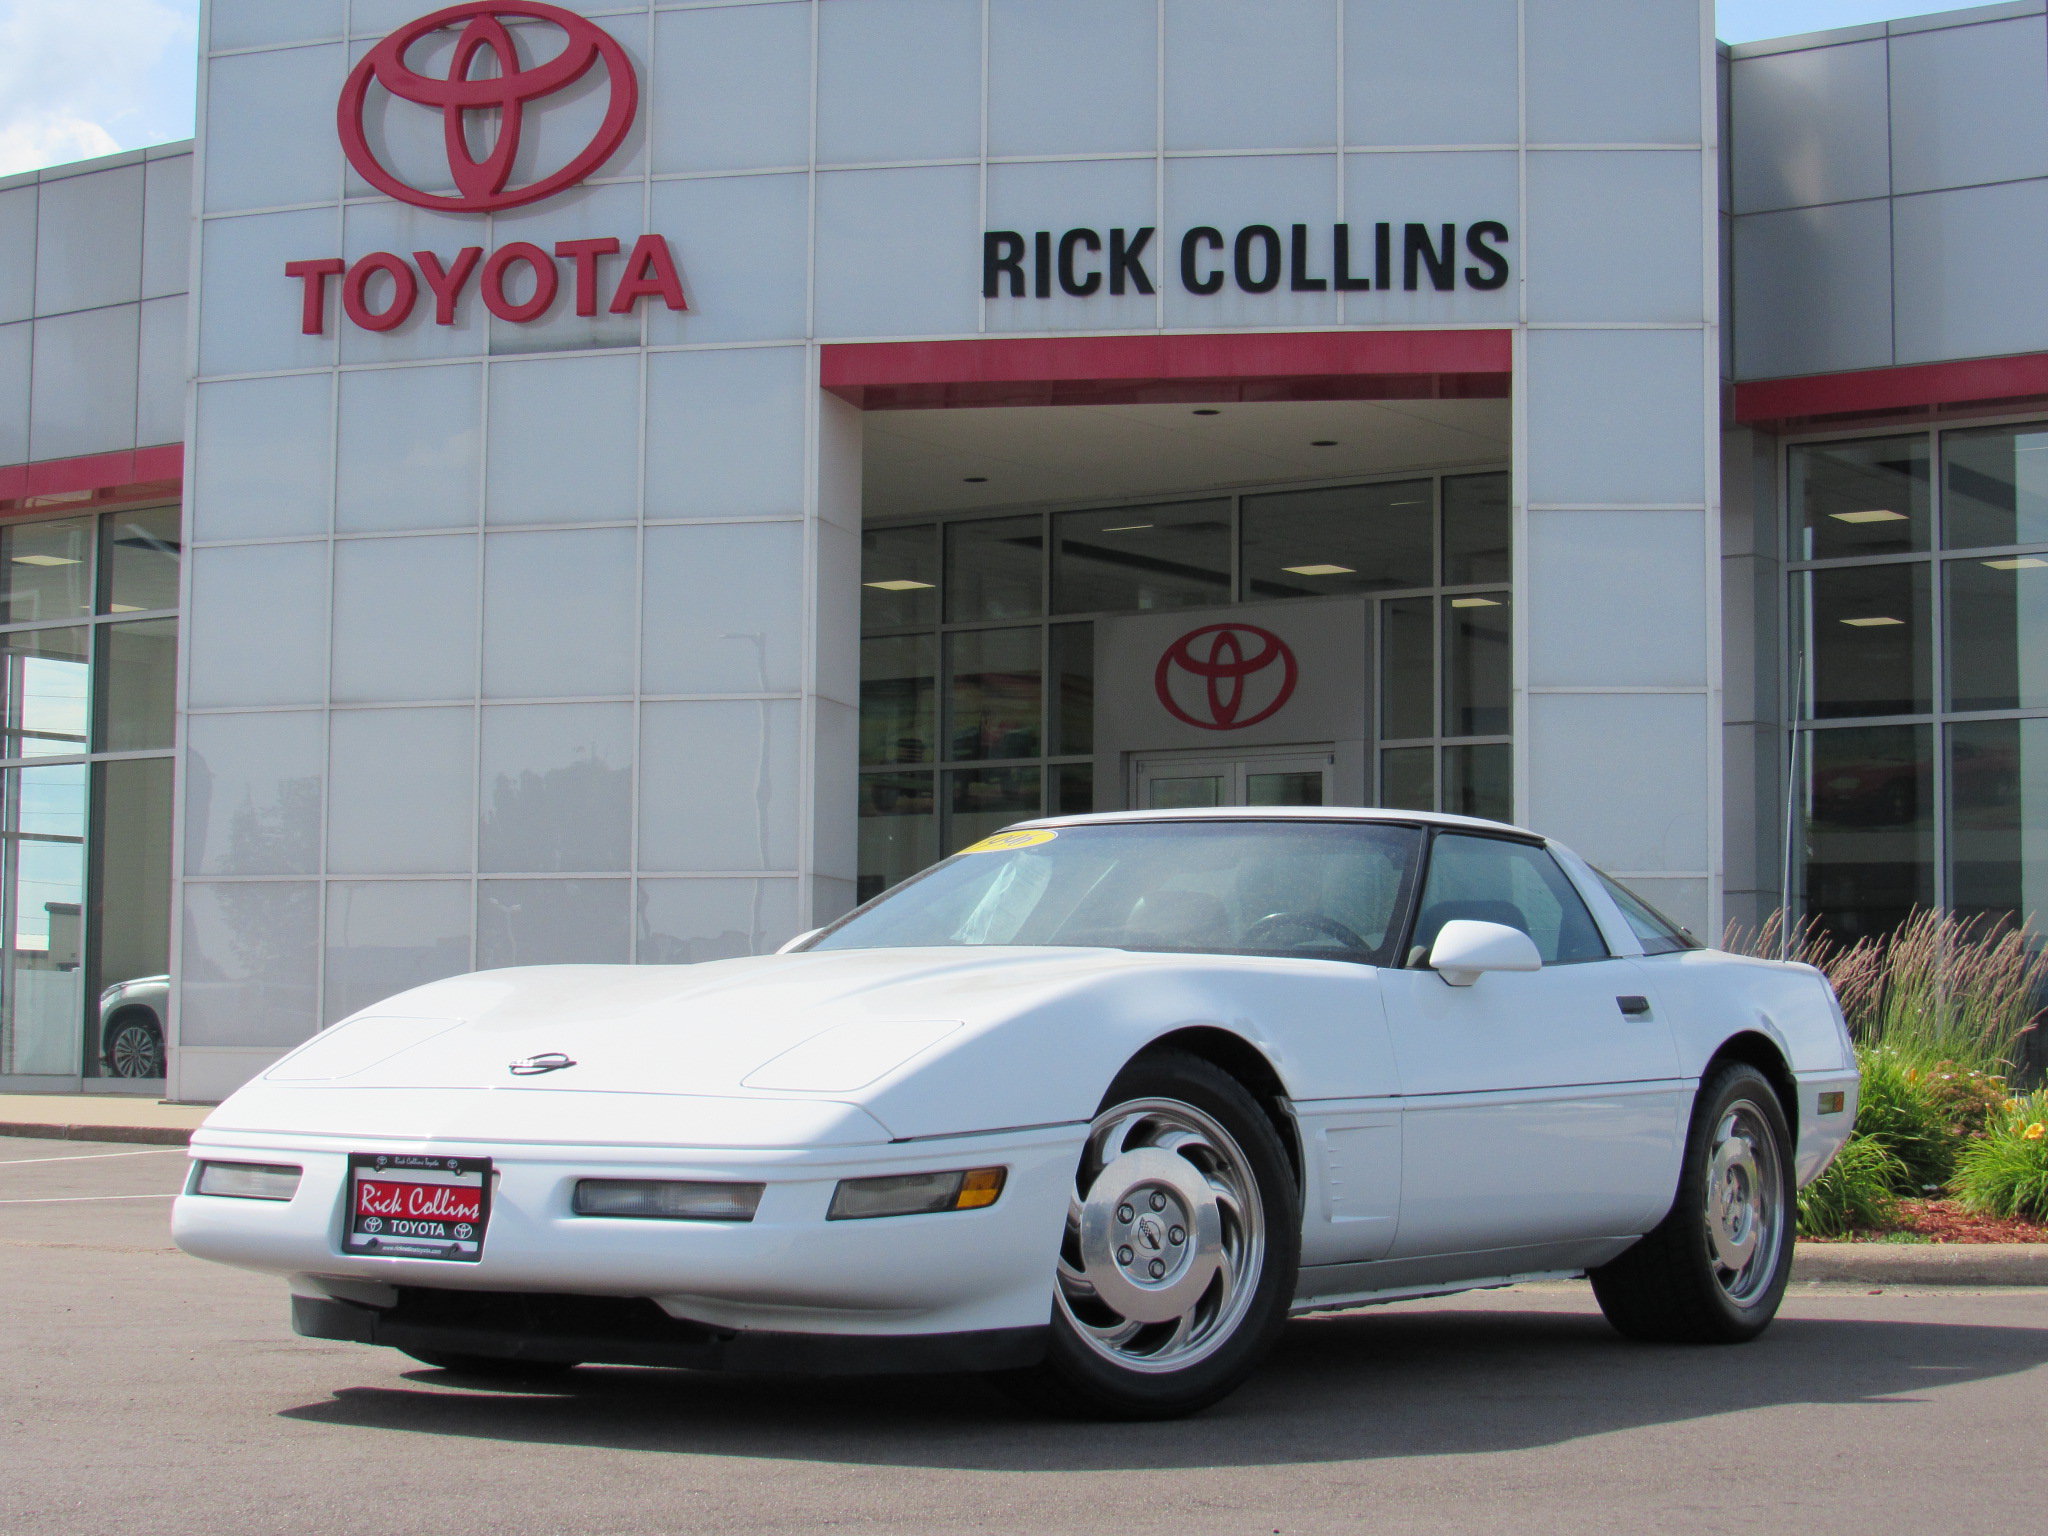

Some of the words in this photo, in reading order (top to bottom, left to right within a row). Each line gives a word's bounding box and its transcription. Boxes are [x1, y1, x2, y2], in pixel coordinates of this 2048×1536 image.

[285, 233, 688, 335] TOYOTA
[983, 227, 1156, 298] RICK
[1180, 220, 1510, 296] COLLINS
[361, 1184, 402, 1214] Rick
[408, 1187, 480, 1220] Collins
[391, 1219, 445, 1237] TOYOTA
